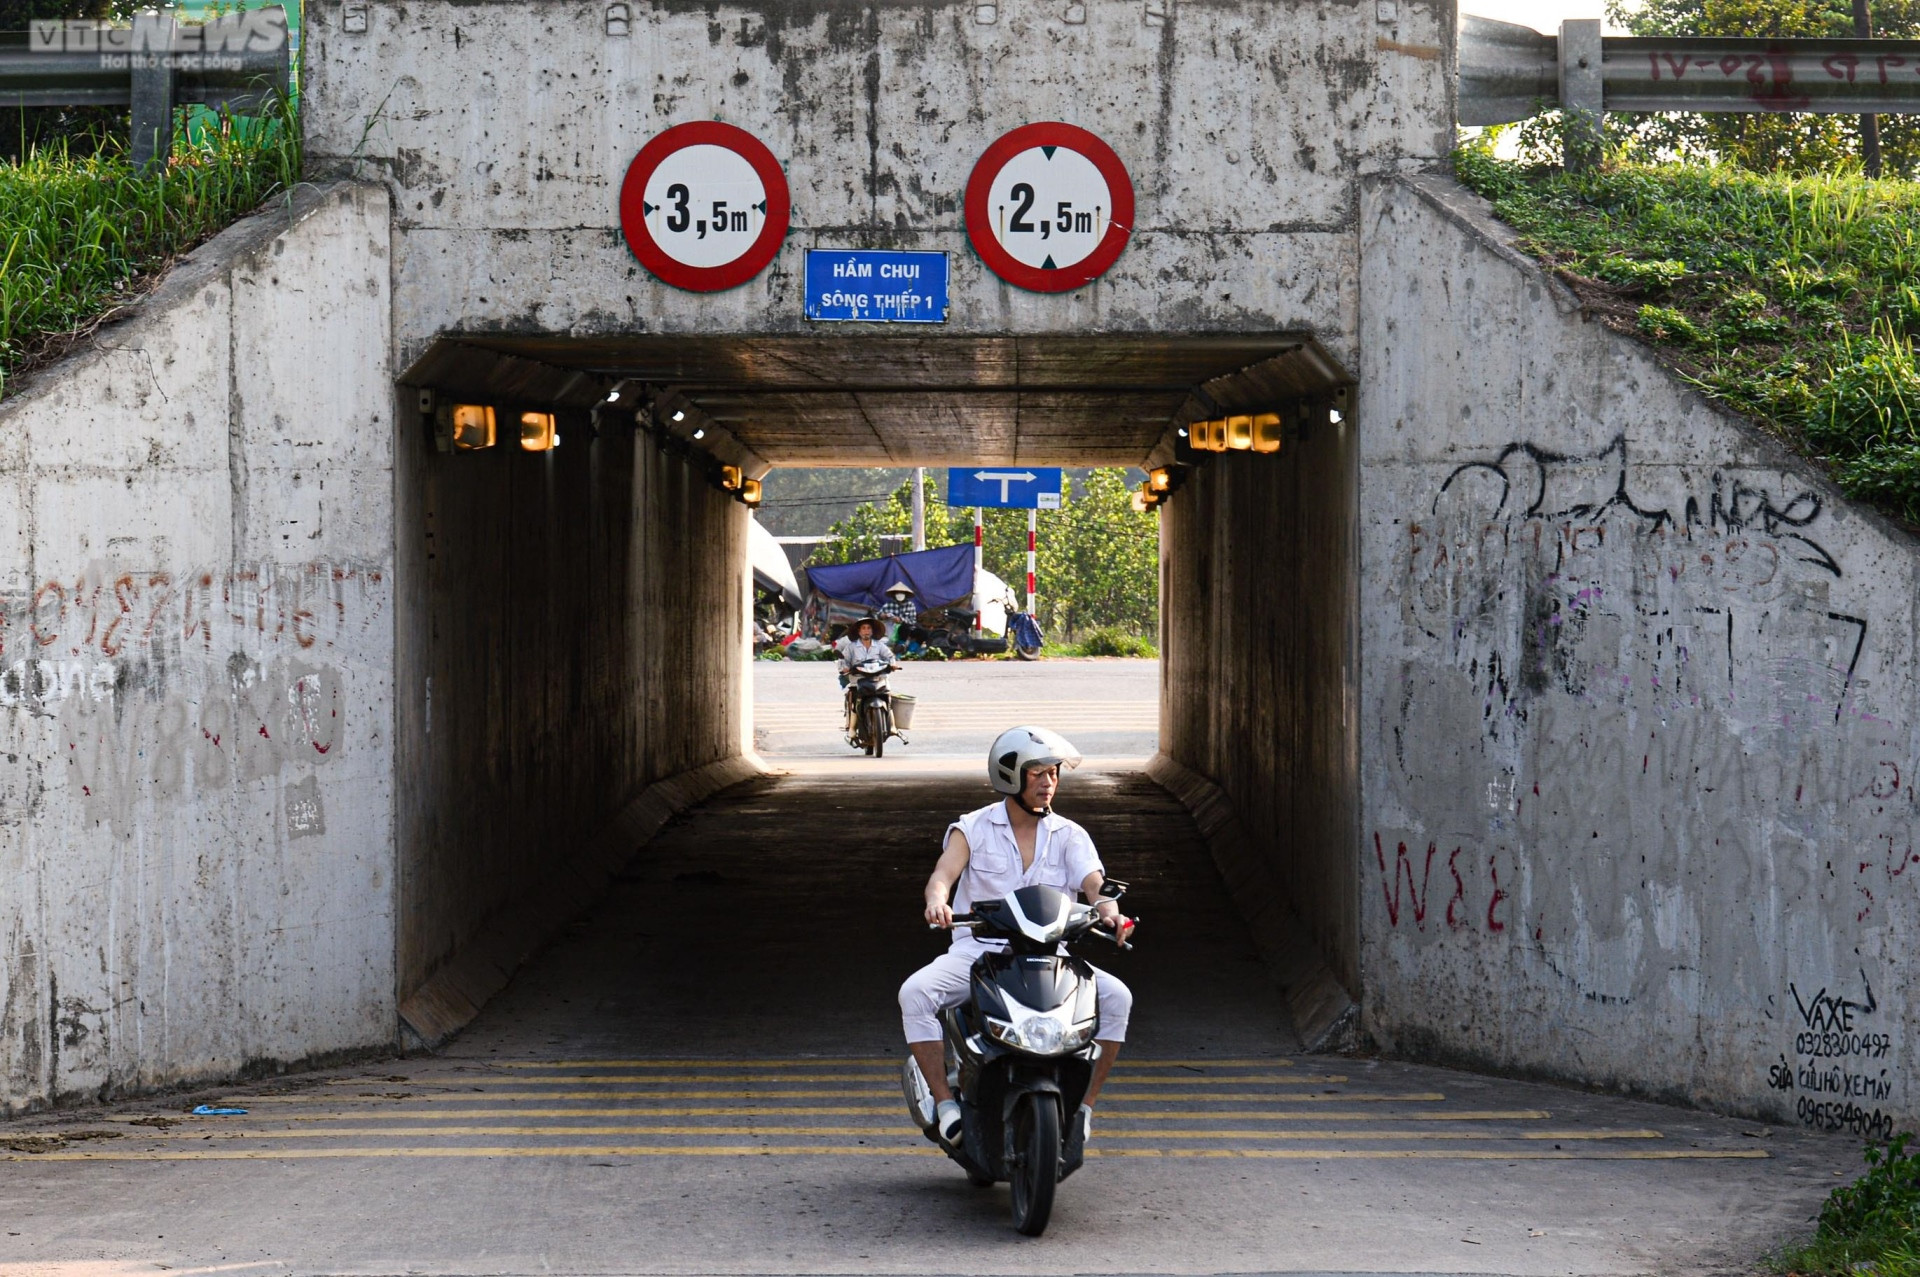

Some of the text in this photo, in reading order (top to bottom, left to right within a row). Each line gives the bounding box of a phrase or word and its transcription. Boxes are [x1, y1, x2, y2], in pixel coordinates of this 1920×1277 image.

[666, 183, 748, 240] 3,5m
[1009, 182, 1092, 240] 2,5m
[833, 256, 920, 279] HẦM CHUI
[821, 288, 933, 309] SÔNG THIẾP 1
[1796, 1031, 1891, 1060] 0328300497
